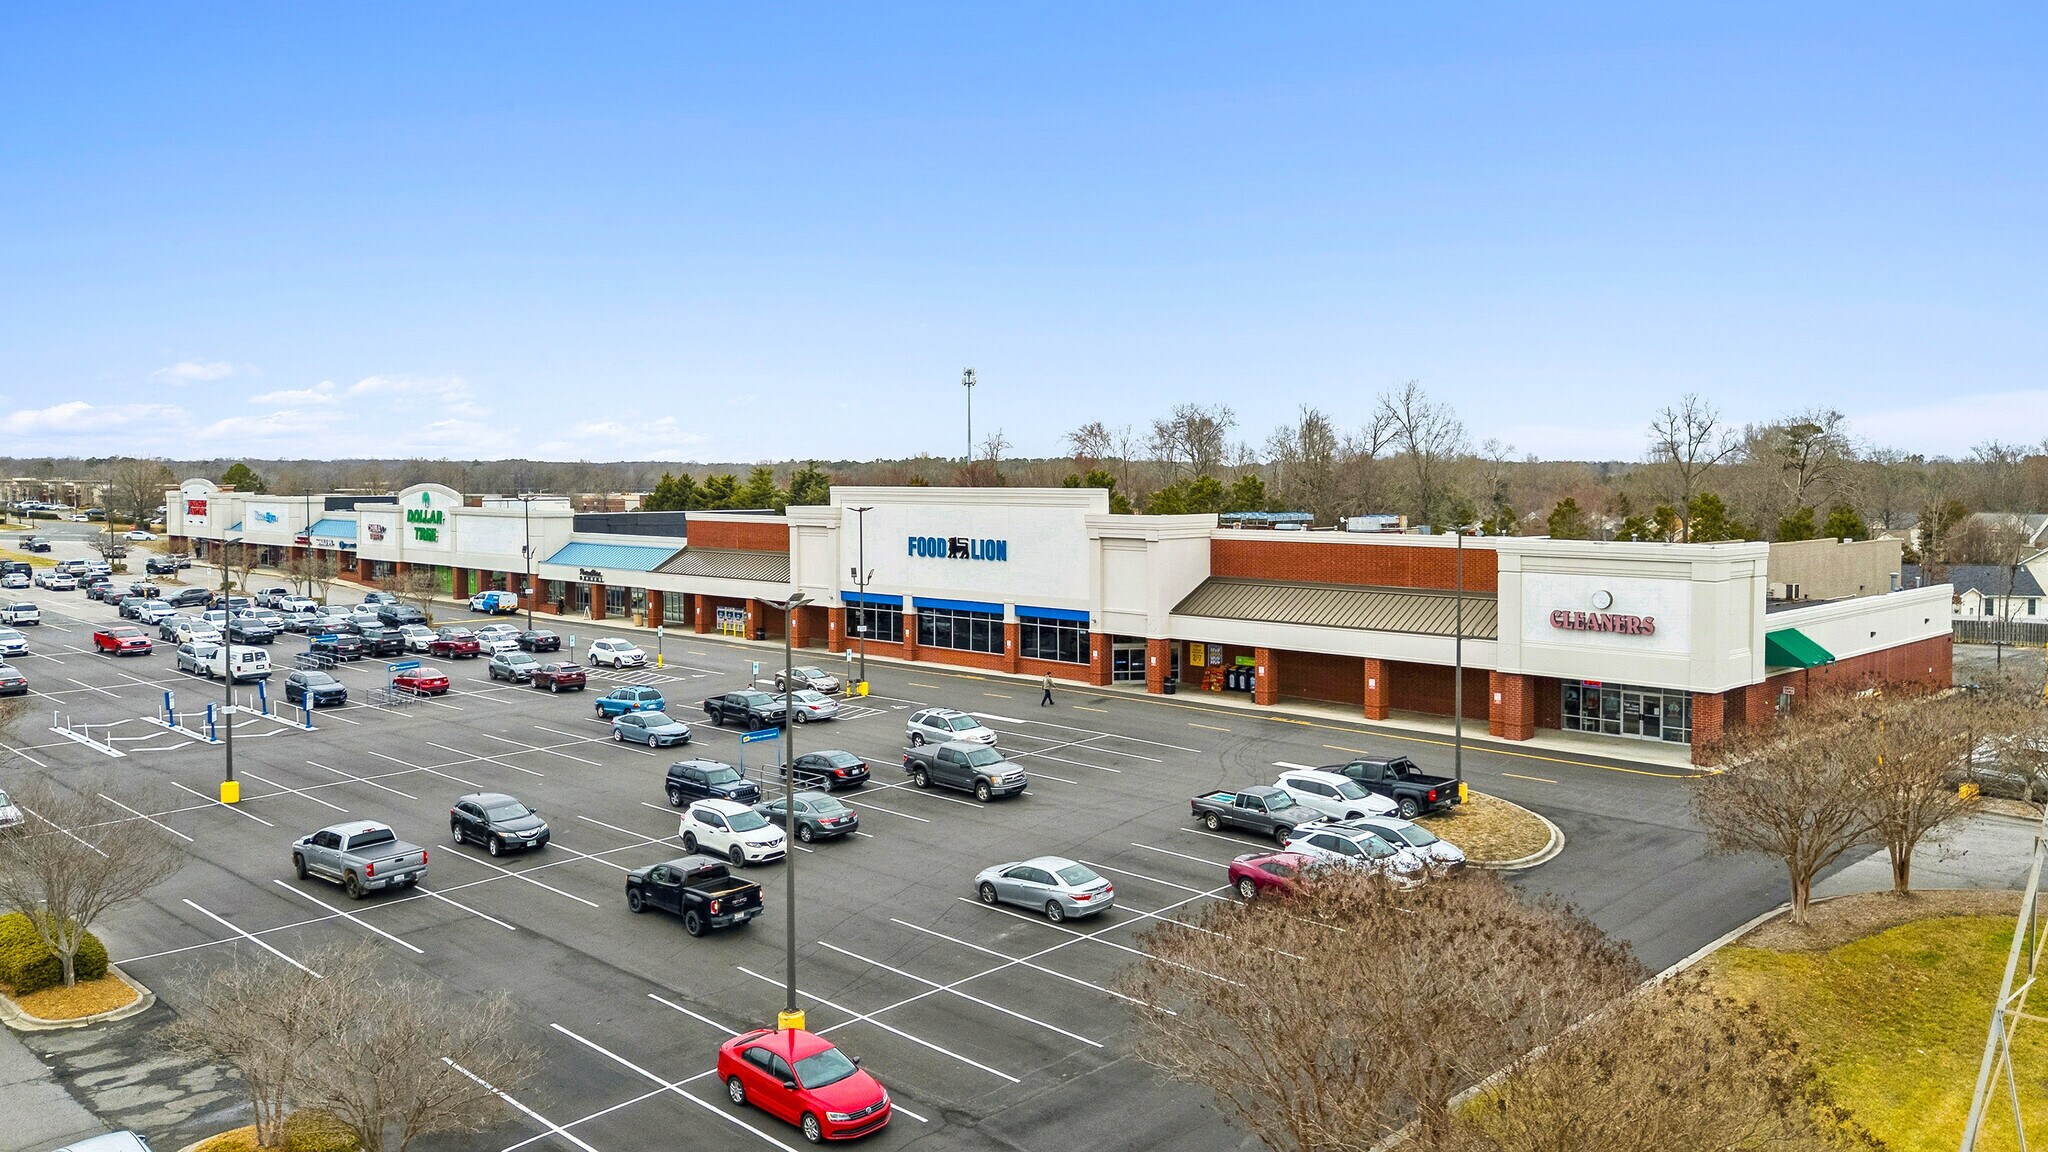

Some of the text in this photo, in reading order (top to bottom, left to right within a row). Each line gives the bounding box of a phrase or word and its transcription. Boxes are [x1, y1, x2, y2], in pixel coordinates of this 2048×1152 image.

[407, 509, 444, 524] DOLLAR
[414, 527, 438, 542] TREE
[908, 536, 1007, 561] FOOD LION
[1550, 610, 1656, 636] CLEANERS
